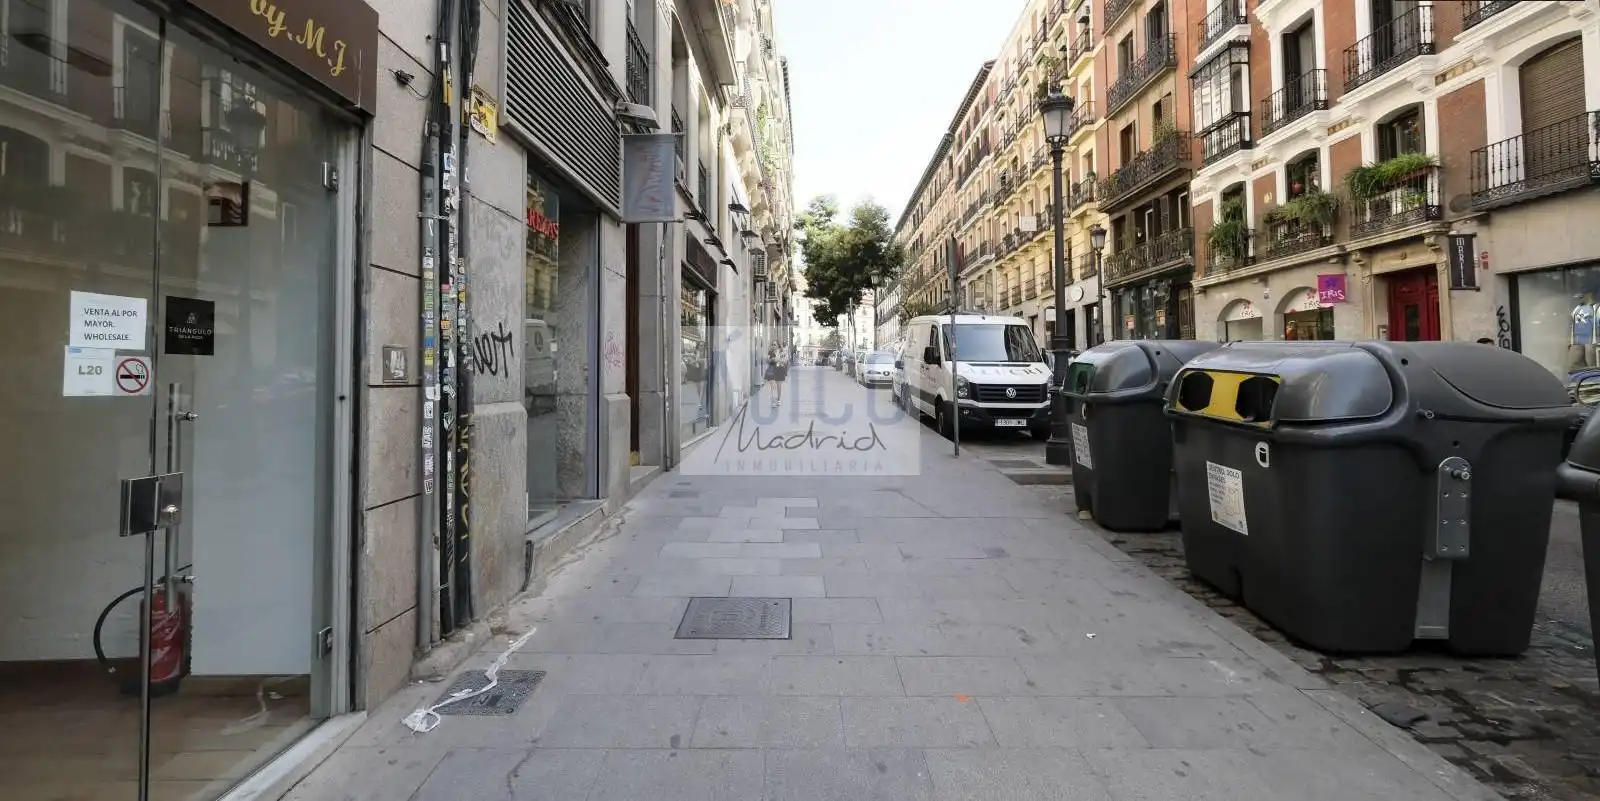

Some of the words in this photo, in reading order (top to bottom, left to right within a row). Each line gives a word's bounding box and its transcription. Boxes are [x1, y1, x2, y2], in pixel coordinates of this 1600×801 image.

[1320, 289, 1345, 300] IRIS
[83, 308, 109, 317] VENTA
[111, 309, 121, 317] AL
[78, 365, 103, 376] L20
